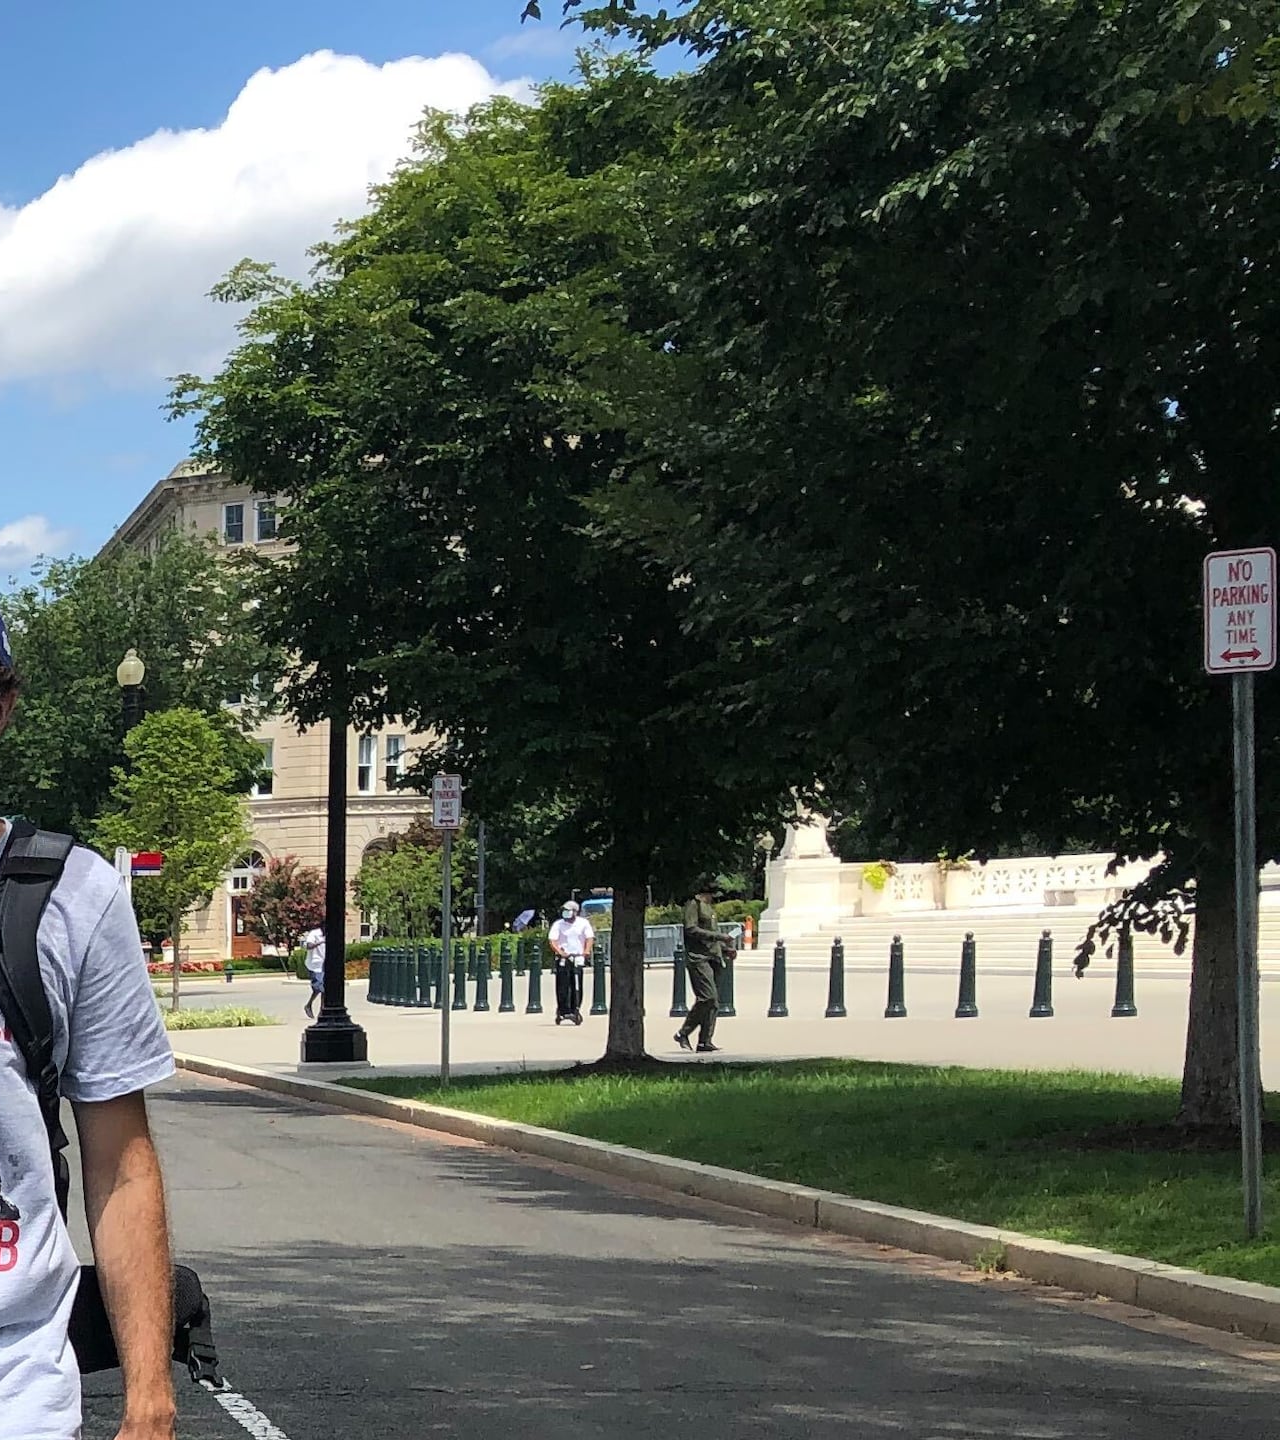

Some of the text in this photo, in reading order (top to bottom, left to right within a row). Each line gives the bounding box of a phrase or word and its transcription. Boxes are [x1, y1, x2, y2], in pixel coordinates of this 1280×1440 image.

[1228, 560, 1253, 582] NO
[1212, 584, 1269, 607] PARKING
[1227, 610, 1255, 626] ANY
[1225, 628, 1258, 645] TIME
